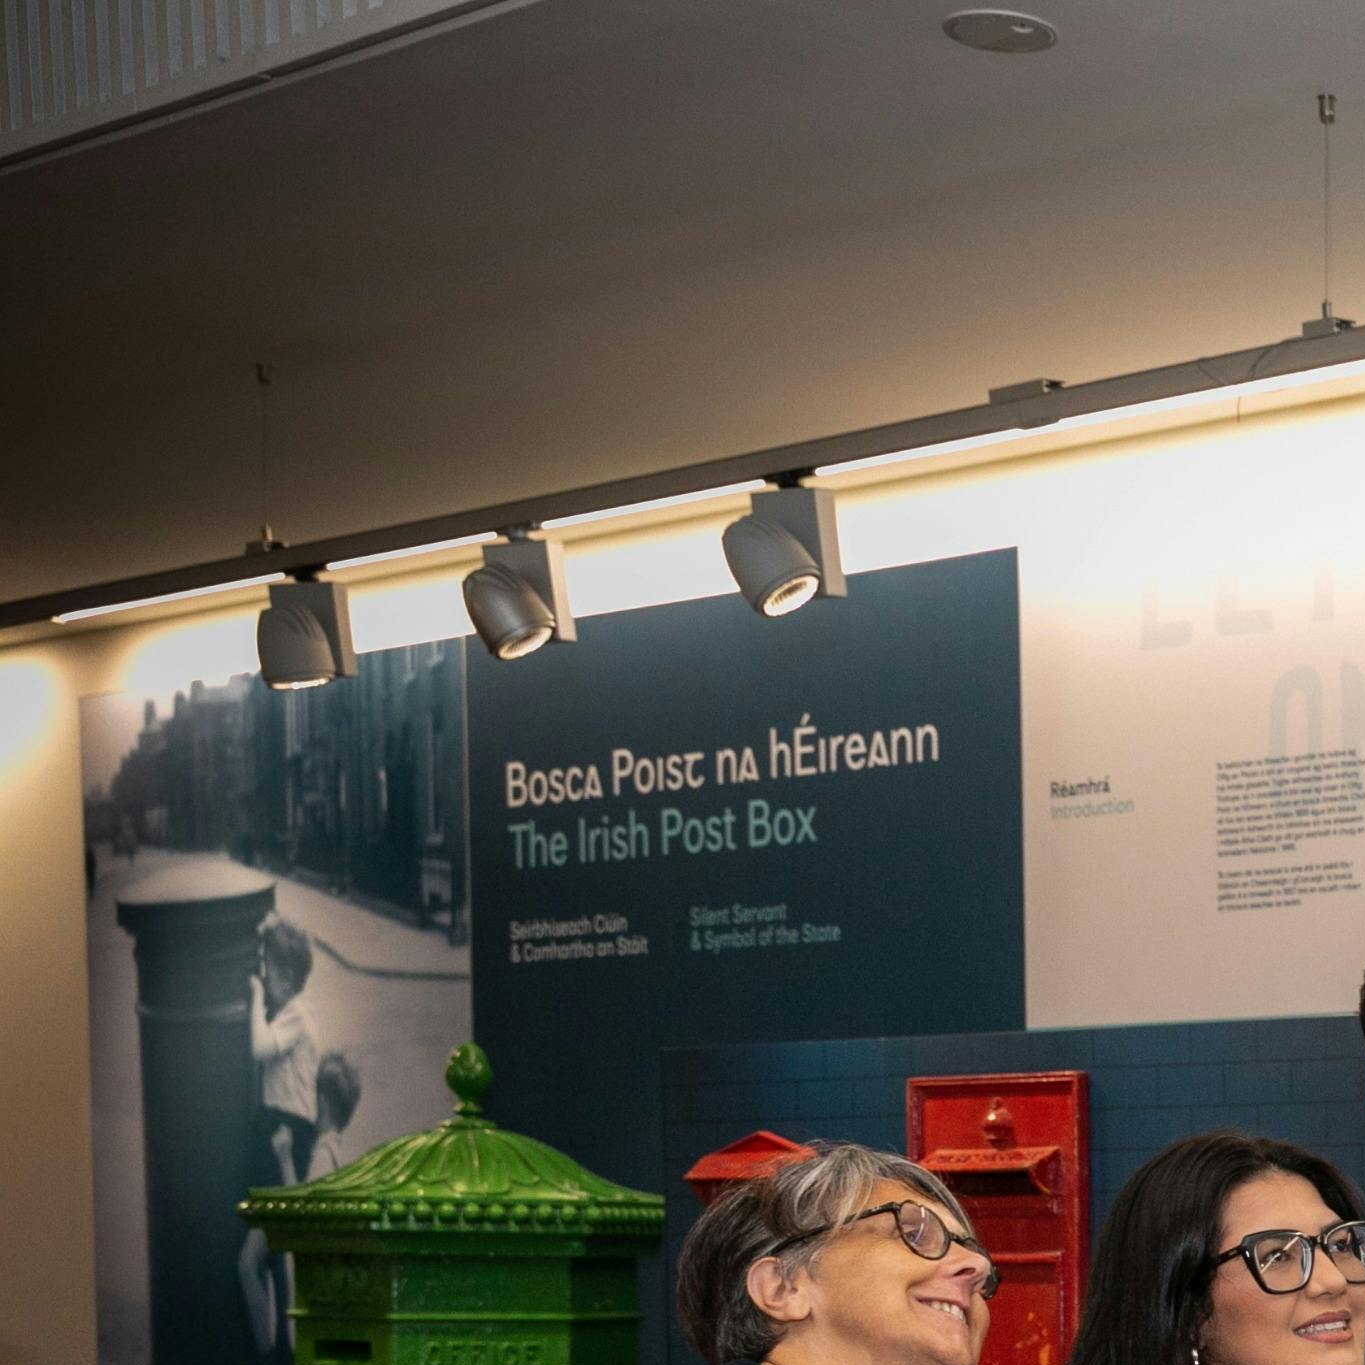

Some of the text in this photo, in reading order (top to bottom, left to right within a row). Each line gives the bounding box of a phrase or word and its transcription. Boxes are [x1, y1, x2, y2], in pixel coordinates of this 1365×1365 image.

[504, 712, 940, 808] Bosca Poist na hÉireann
[1050, 774, 1111, 798] Réamhrá
[1050, 800, 1135, 819] Introduction
[507, 798, 819, 869] The Irish Post Box
[690, 922, 842, 954] & Symbol of the State
[510, 942, 521, 963] &
